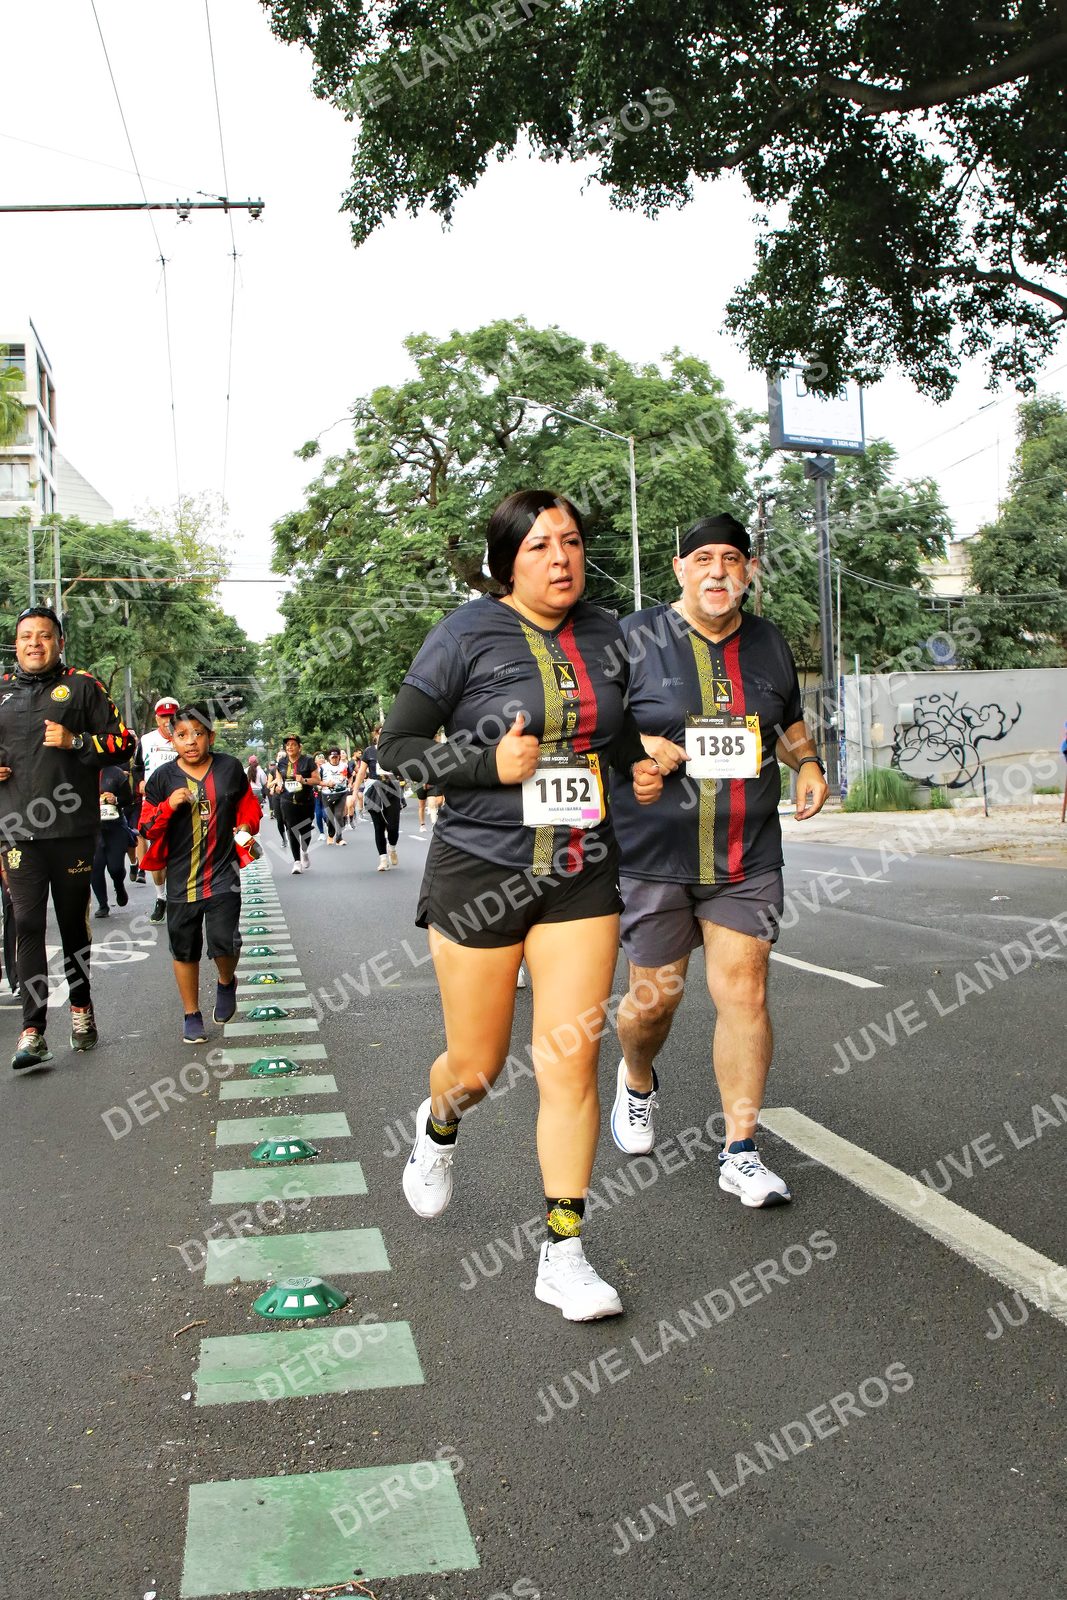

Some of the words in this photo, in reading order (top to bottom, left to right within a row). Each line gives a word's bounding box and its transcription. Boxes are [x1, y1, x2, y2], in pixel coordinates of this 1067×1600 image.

[915, 691, 958, 708] TOY
[696, 735, 746, 756] 1385
[535, 778, 591, 803] 1152
